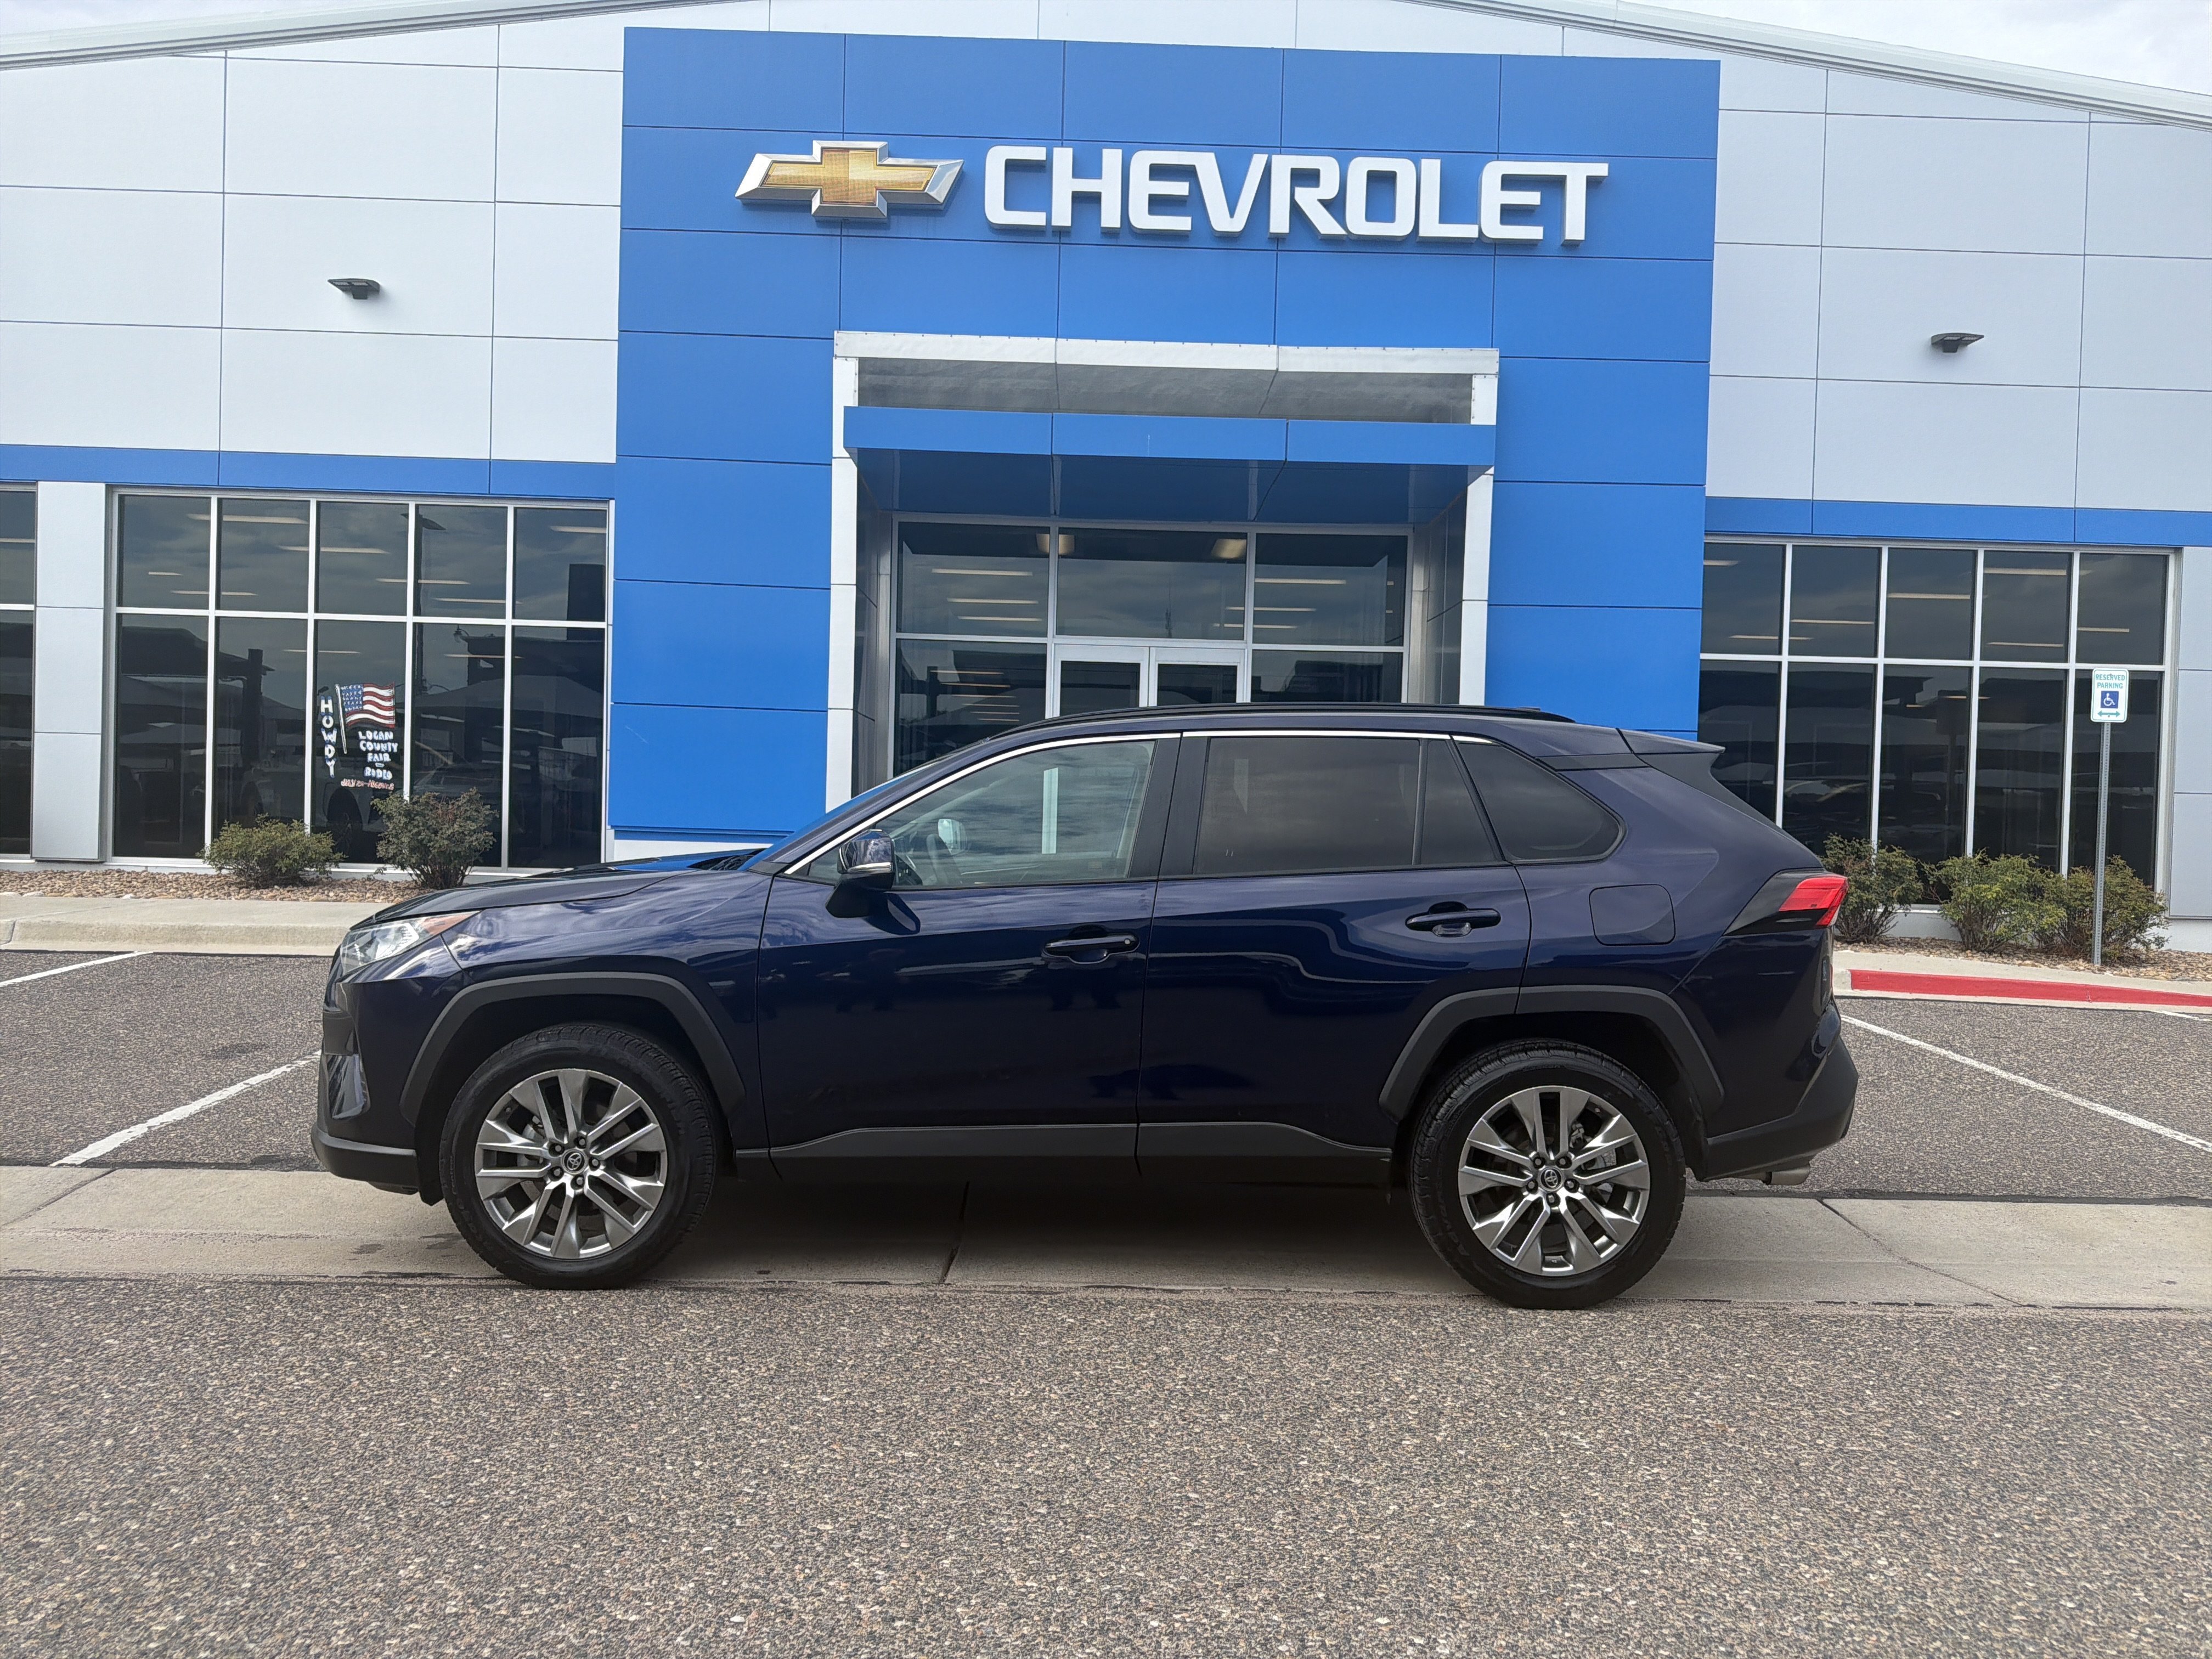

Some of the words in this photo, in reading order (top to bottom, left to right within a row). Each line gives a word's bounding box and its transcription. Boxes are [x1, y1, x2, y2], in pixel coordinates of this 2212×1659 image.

[984, 145, 1609, 243] CHEVROLET
[320, 695, 337, 778] HOWDY
[358, 730, 394, 741] LOGAN
[359, 740, 398, 753] COUNTY
[367, 753, 391, 763] FAIR
[364, 766, 393, 780] RODEO
